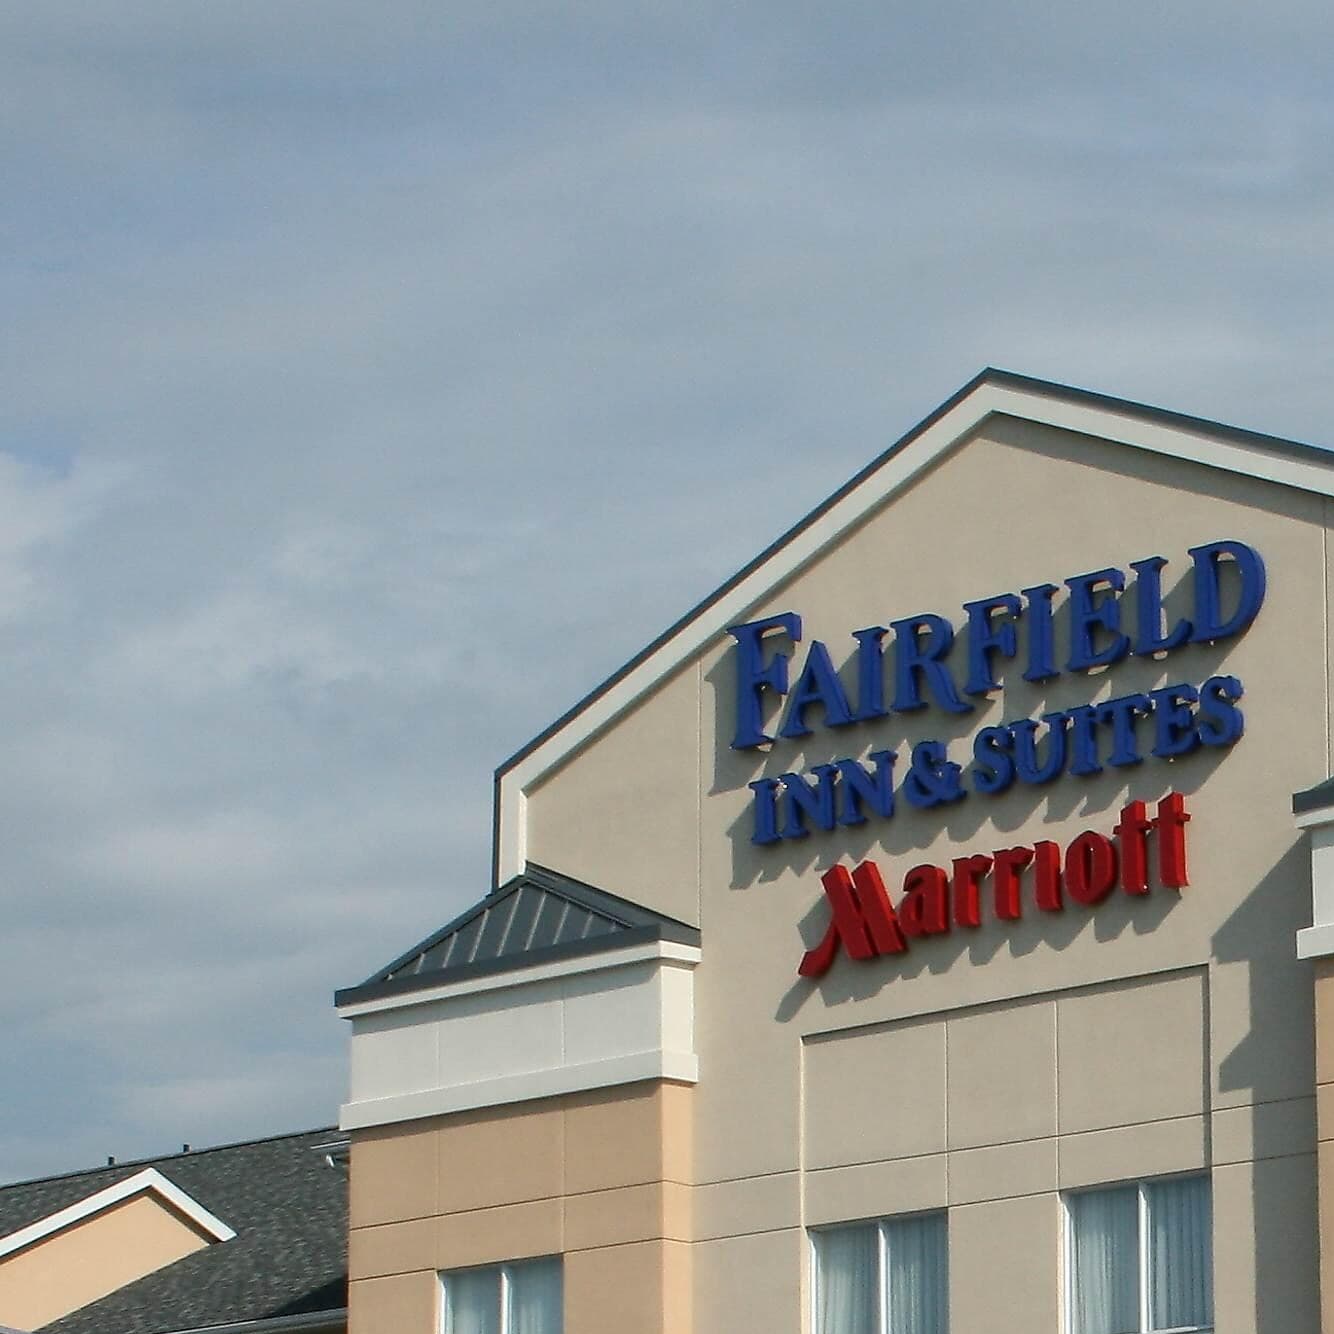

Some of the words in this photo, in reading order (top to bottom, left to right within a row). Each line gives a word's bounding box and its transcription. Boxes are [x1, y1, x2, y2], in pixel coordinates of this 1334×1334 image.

[727, 540, 1266, 750] FAIRFIELD
[749, 751, 897, 846] INN
[903, 740, 967, 809] &
[972, 675, 1245, 794] SUITES
[798, 792, 1191, 978] Marriott
